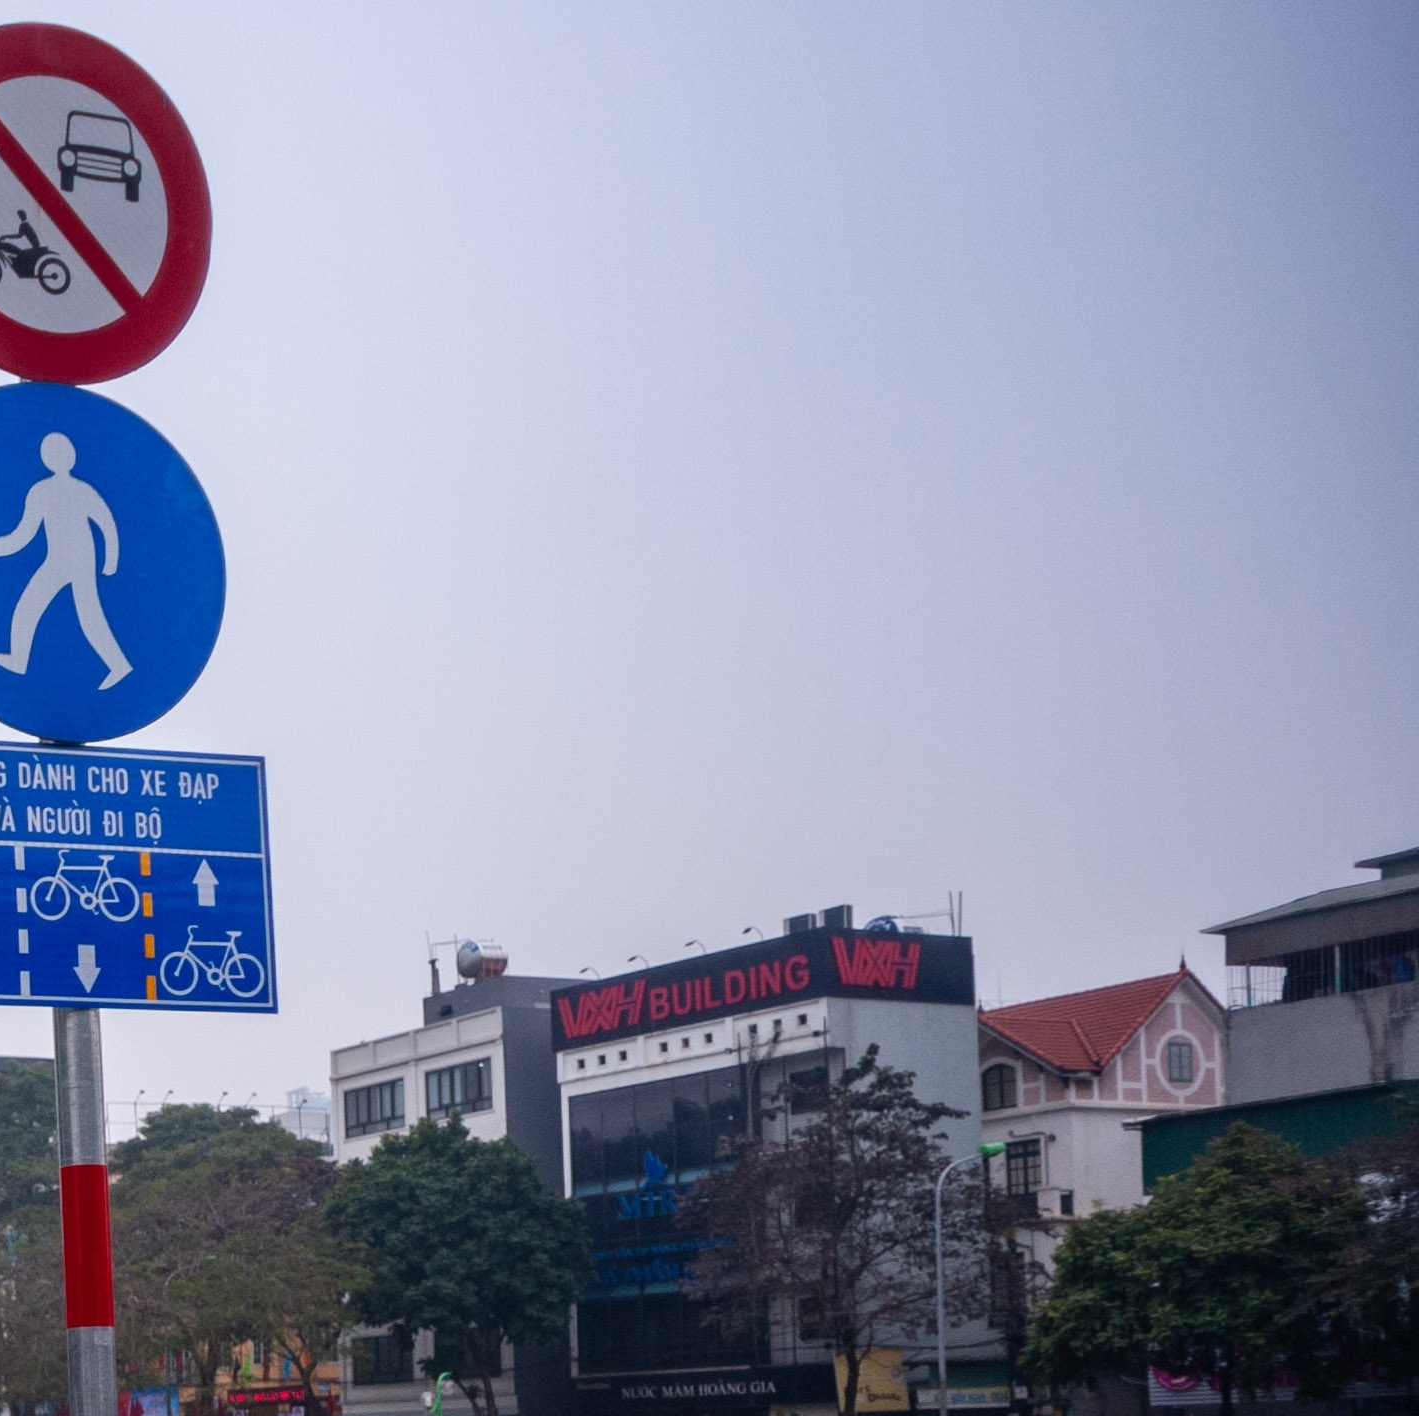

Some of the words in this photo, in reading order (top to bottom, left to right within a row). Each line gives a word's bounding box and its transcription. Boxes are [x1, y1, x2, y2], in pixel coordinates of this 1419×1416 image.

[18, 755, 76, 793] DÀNH
[87, 766, 129, 795] CHO
[140, 769, 167, 797] XE
[178, 772, 220, 805] ĐẠP
[27, 800, 92, 837] NGƯỜI
[103, 809, 124, 838] ĐI
[135, 807, 163, 846] BỘ
[649, 954, 811, 1022] BUILDING
[749, 1380, 777, 1395] GIA
